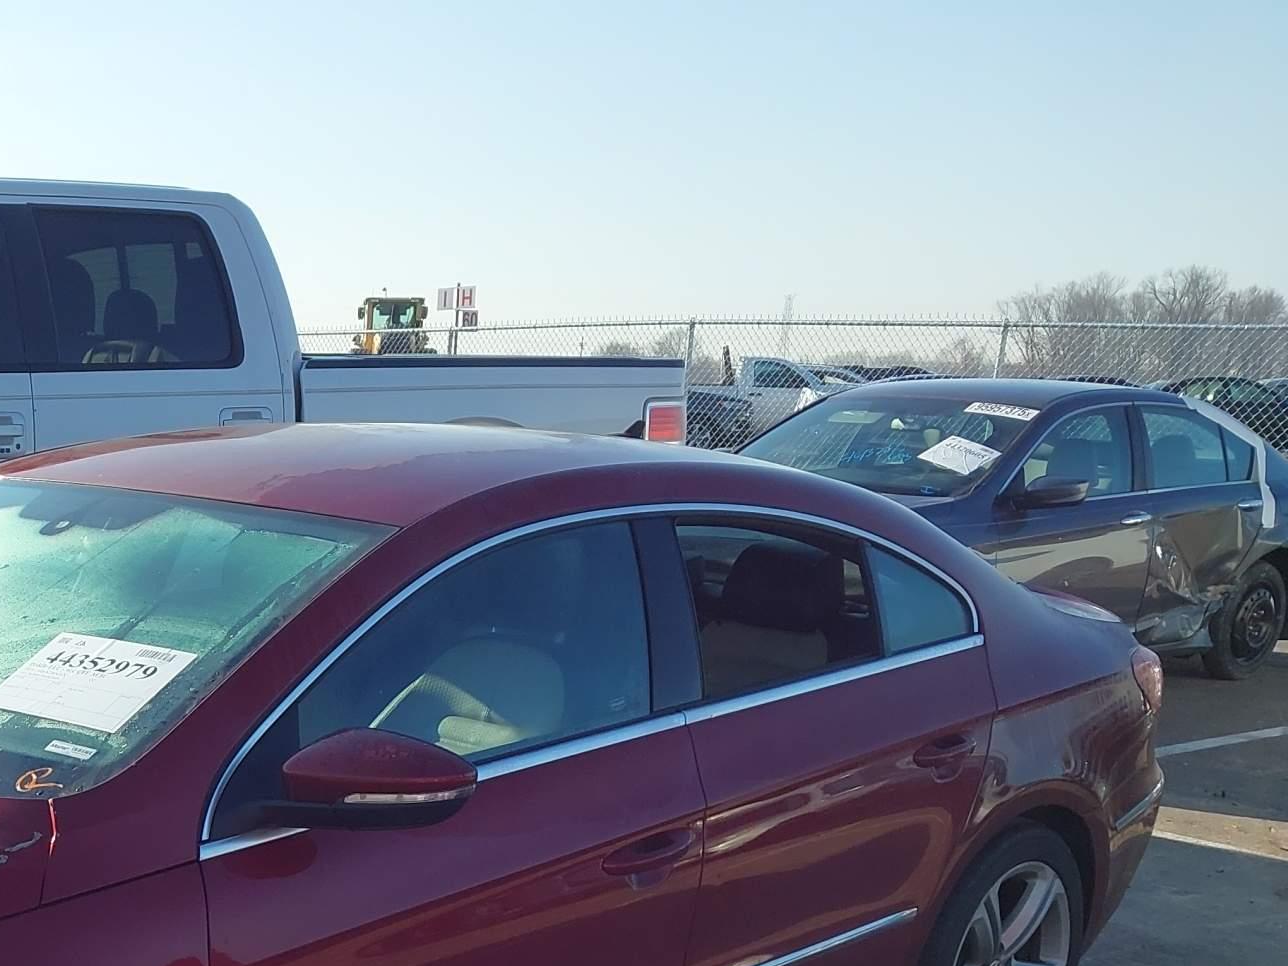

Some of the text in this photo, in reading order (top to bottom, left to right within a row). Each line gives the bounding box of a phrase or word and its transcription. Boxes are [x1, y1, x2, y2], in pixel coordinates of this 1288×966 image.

[462, 288, 473, 306] H
[462, 311, 478, 327] 60
[46, 650, 158, 680] 44352979
